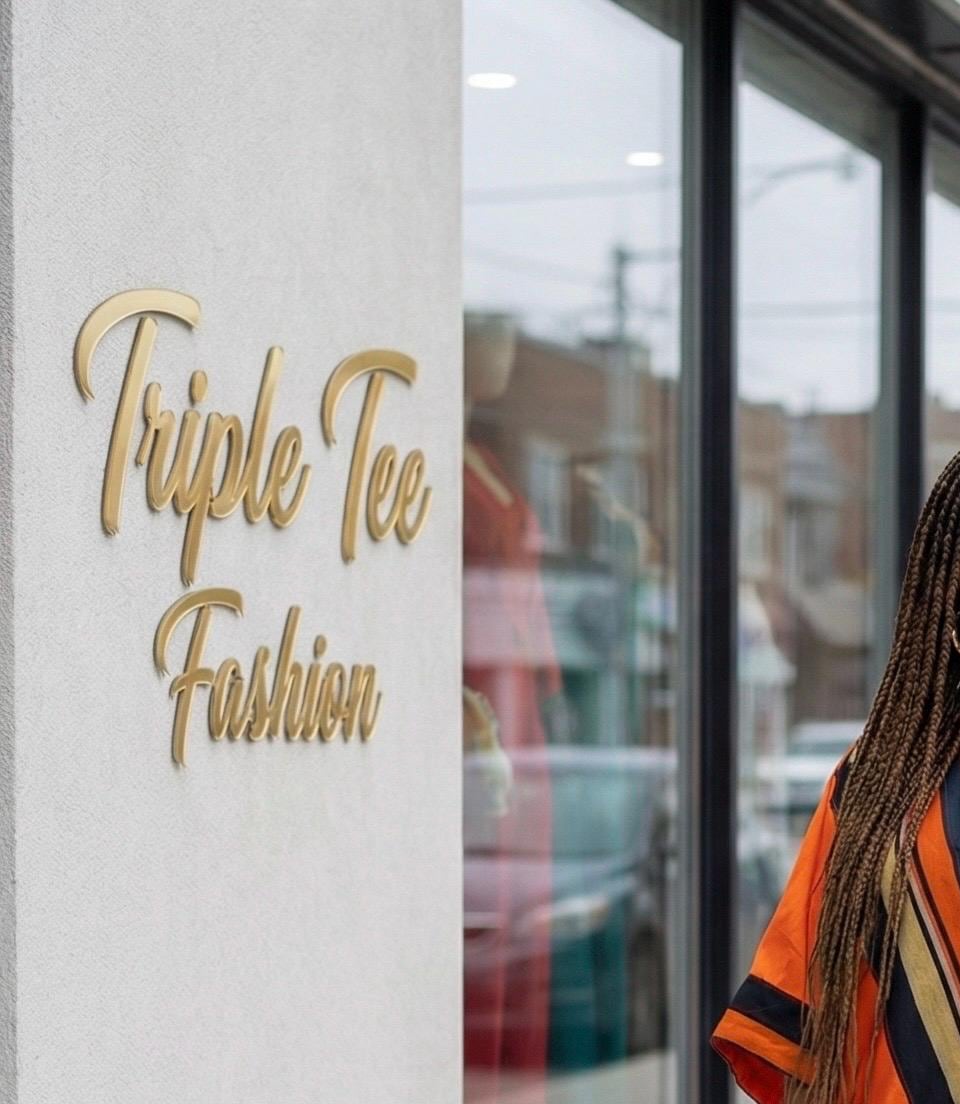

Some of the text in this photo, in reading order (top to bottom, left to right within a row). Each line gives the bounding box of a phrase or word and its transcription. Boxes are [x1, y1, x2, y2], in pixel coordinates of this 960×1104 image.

[74, 288, 432, 585] Triple Tee
[153, 588, 382, 766] Fashion
